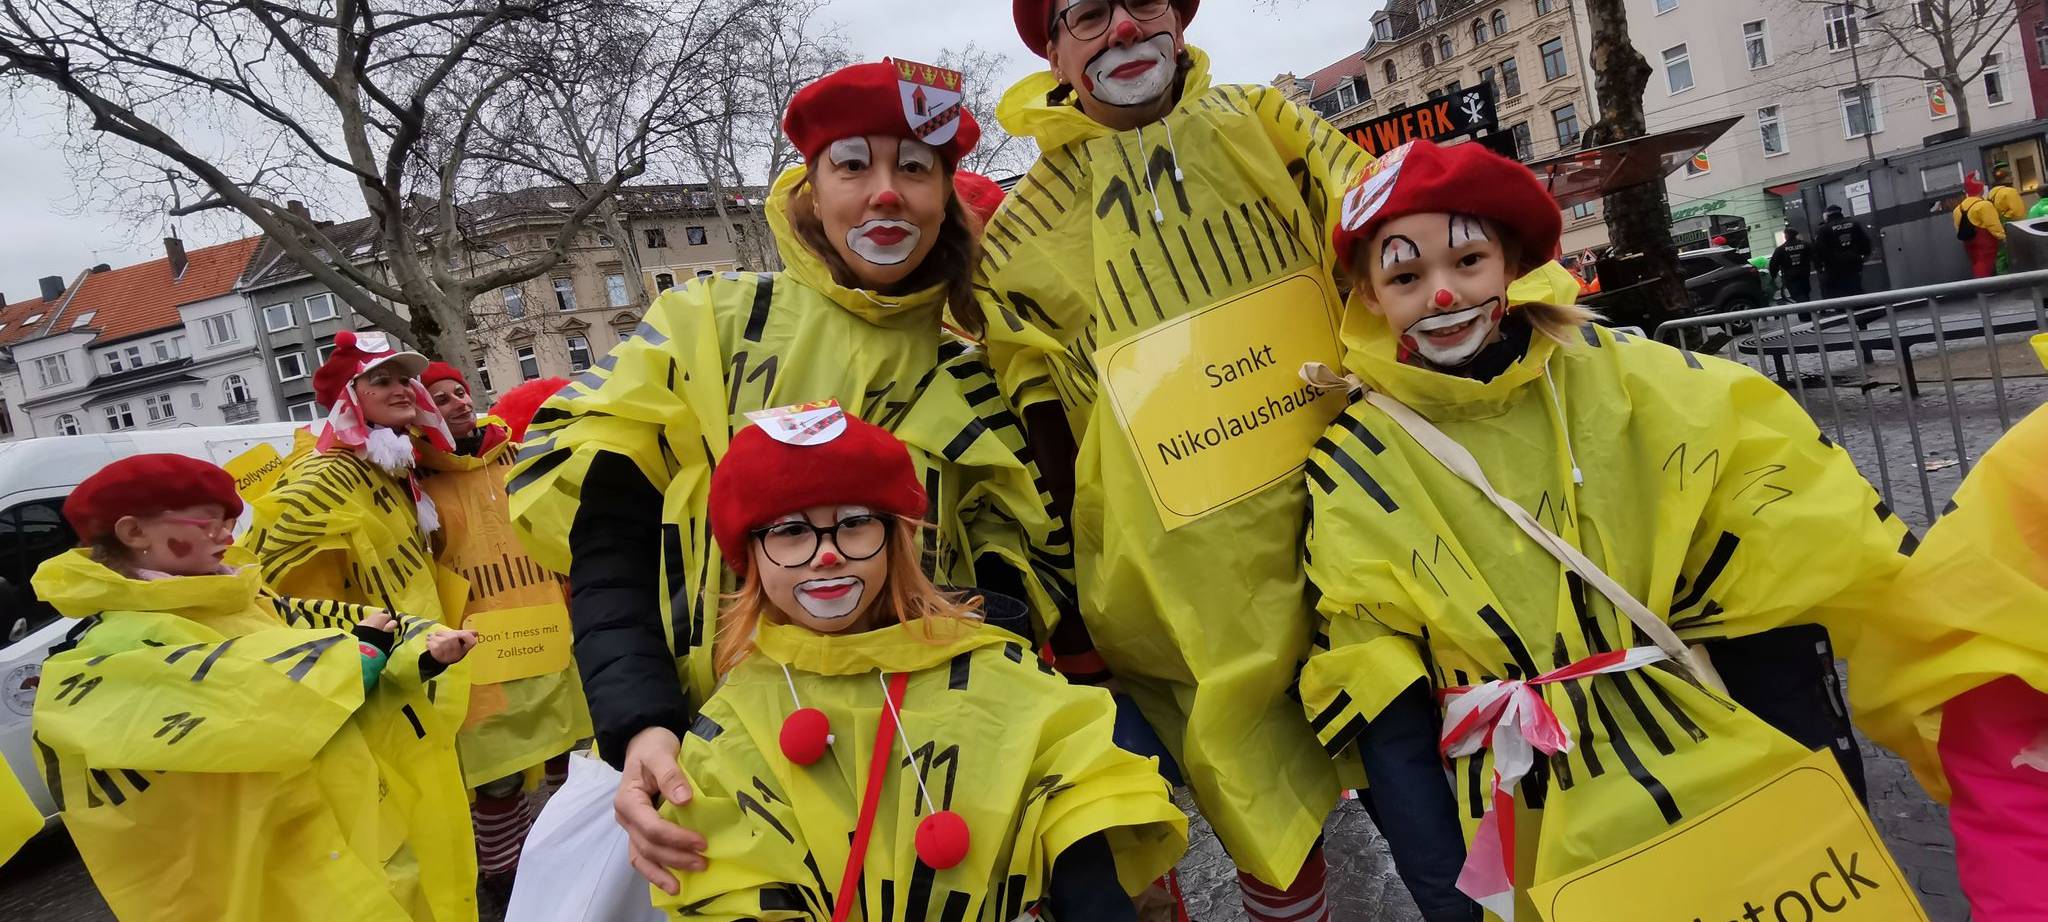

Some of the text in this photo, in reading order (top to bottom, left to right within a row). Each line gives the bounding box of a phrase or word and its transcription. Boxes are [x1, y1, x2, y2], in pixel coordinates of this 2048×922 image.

[1347, 101, 1455, 155] NWERK
[1204, 345, 1276, 388] Sankt
[1157, 382, 1330, 465] Nikolaushause
[235, 456, 282, 490] Zollywood
[513, 627, 540, 638] mess
[542, 624, 559, 634] mit
[497, 643, 544, 658] Zollstock
